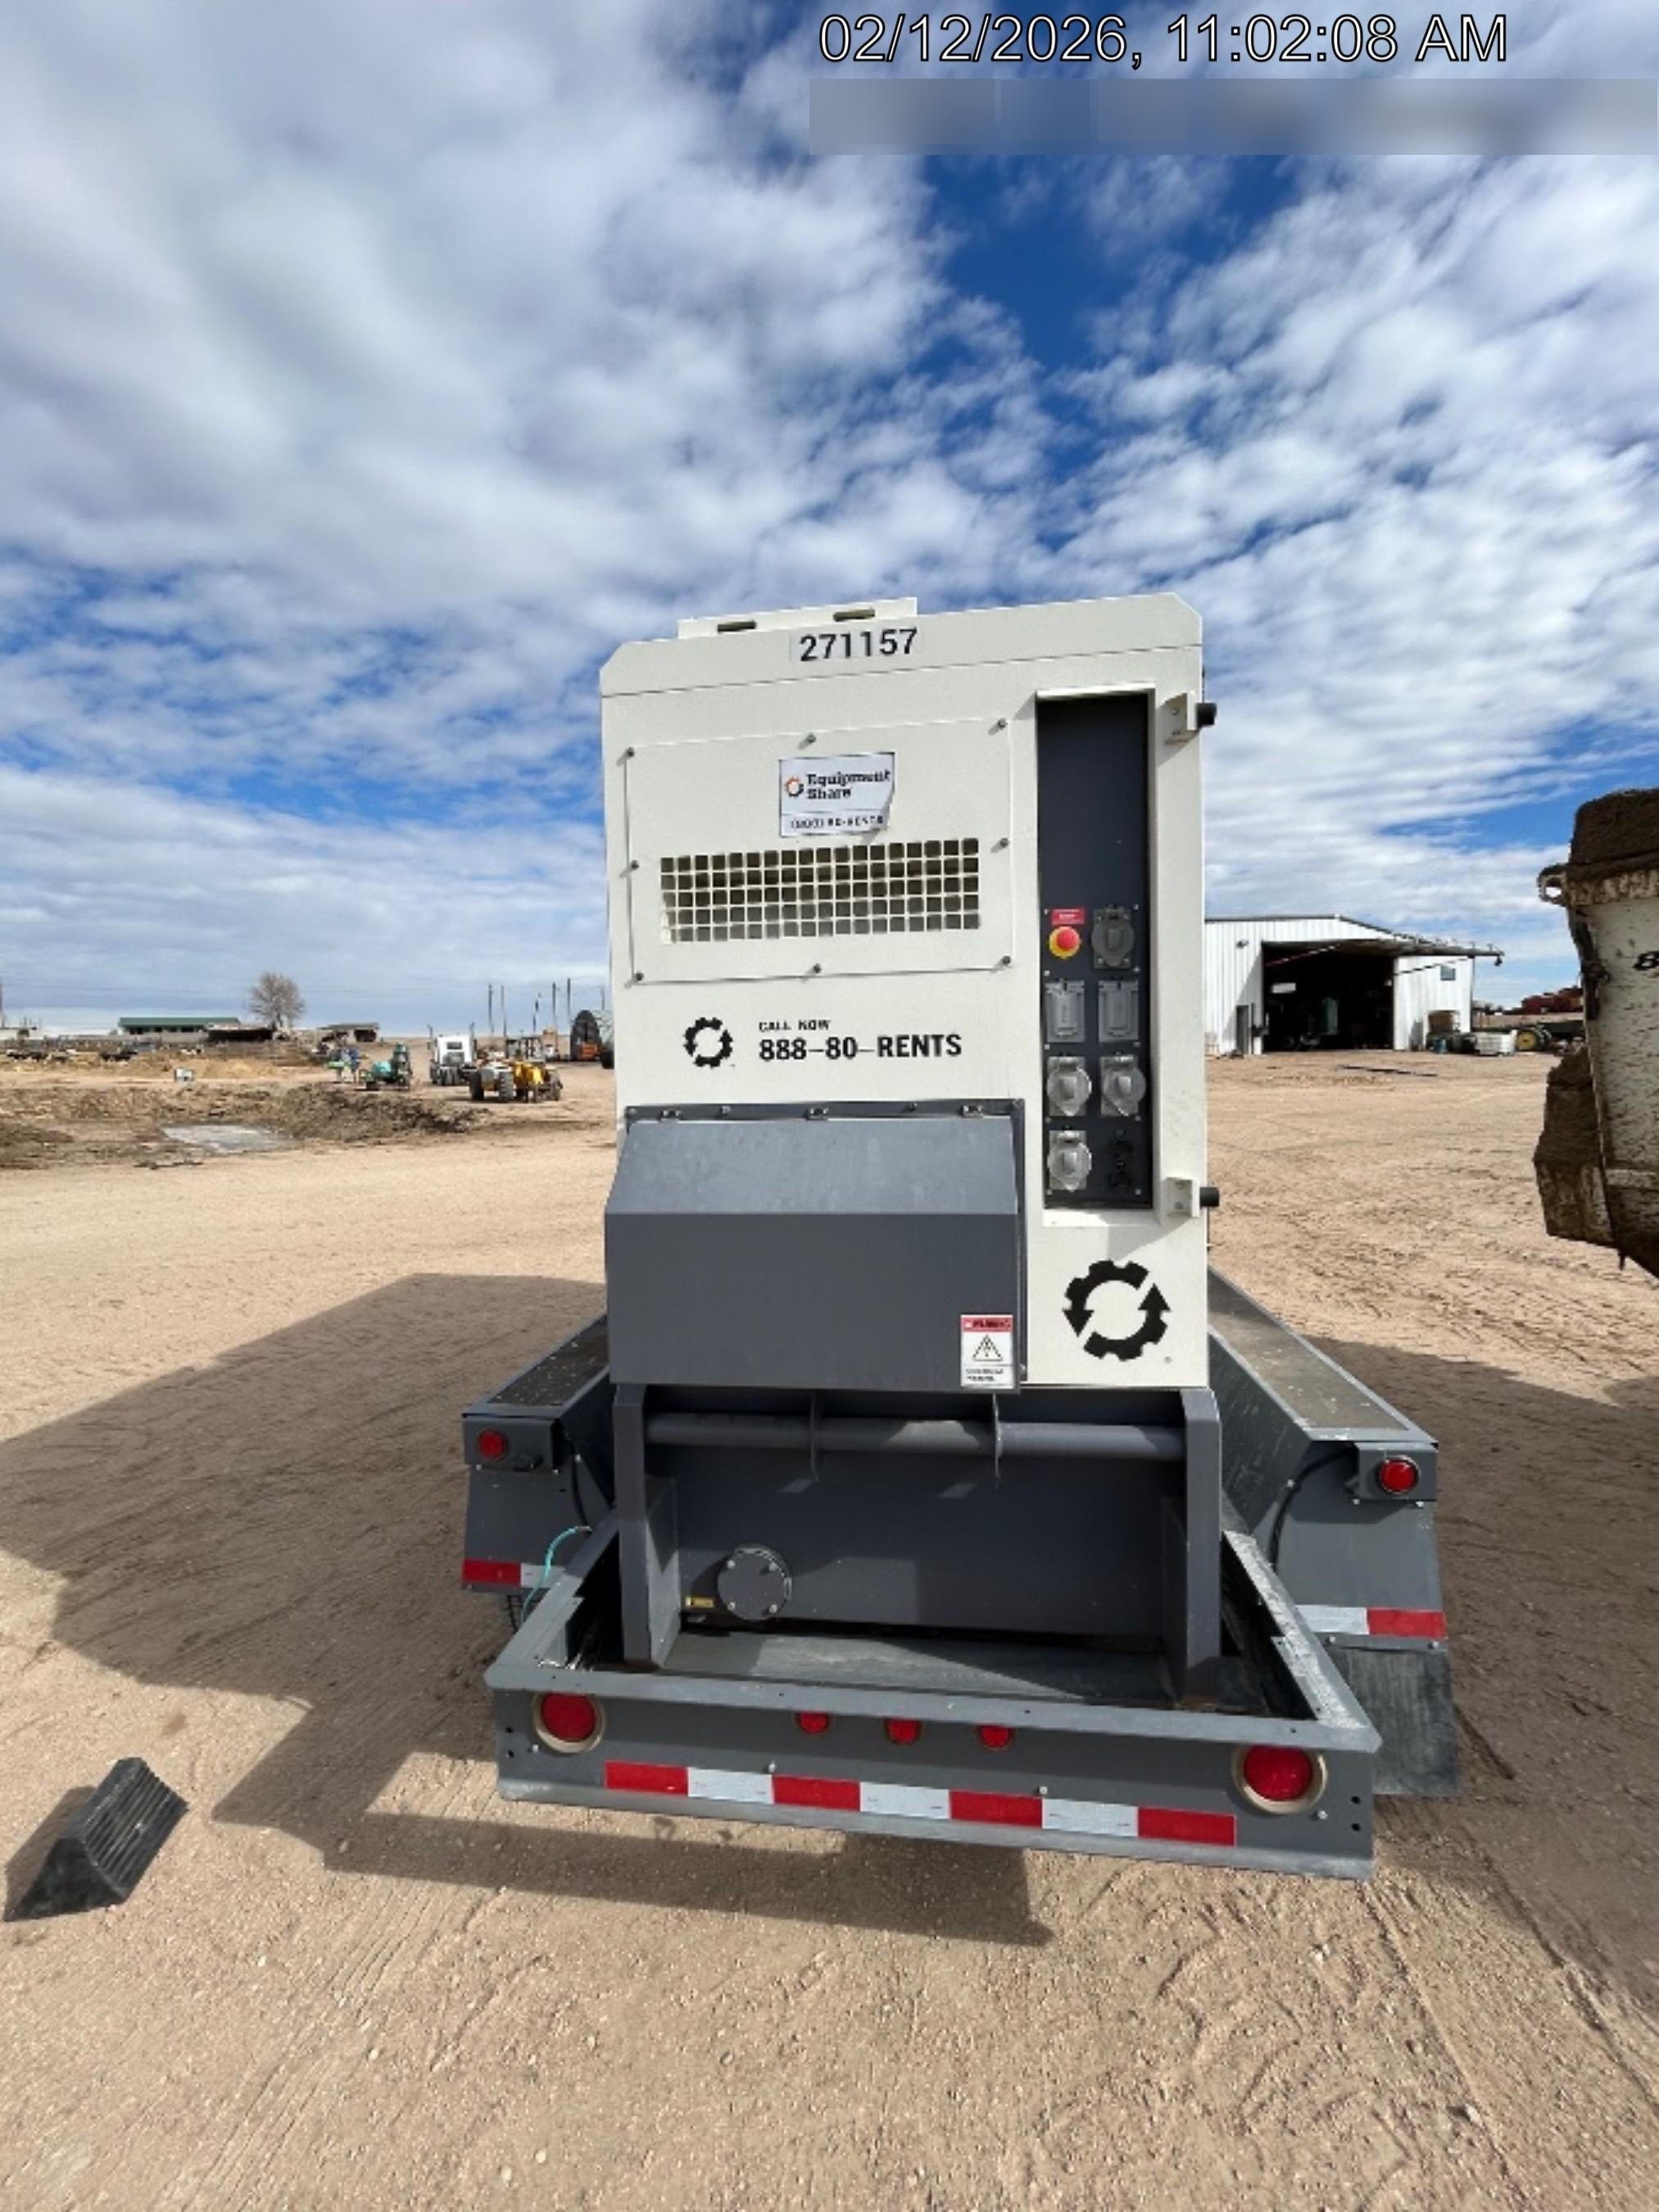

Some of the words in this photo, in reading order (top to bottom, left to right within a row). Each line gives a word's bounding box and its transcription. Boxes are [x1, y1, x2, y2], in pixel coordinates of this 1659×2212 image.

[800, 627, 917, 661] 271157
[807, 768, 891, 786] Equipment
[807, 788, 851, 800] Share
[759, 1021, 791, 1032] CALL
[798, 1019, 831, 1031] NOW
